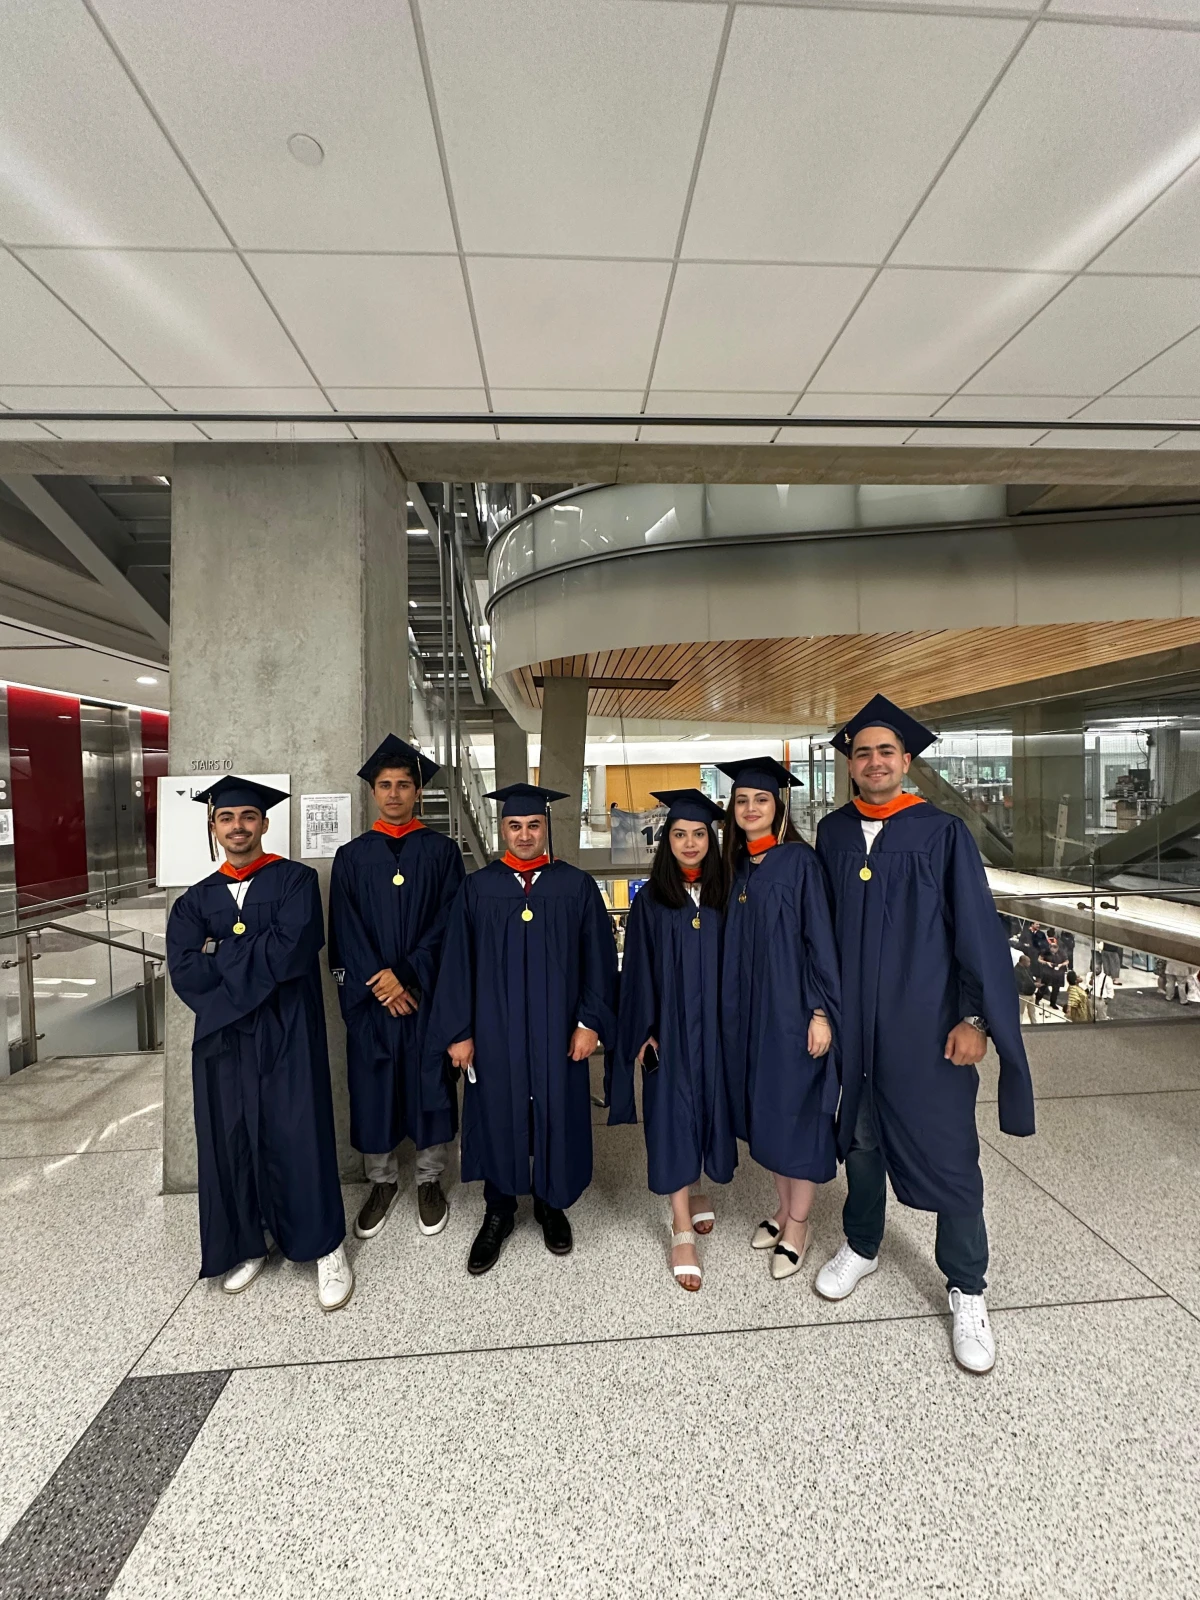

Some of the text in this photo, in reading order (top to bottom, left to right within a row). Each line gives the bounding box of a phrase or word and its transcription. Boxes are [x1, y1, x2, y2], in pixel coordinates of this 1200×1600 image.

[191, 759, 234, 770] STAIRS TO
[190, 787, 204, 798] Le
